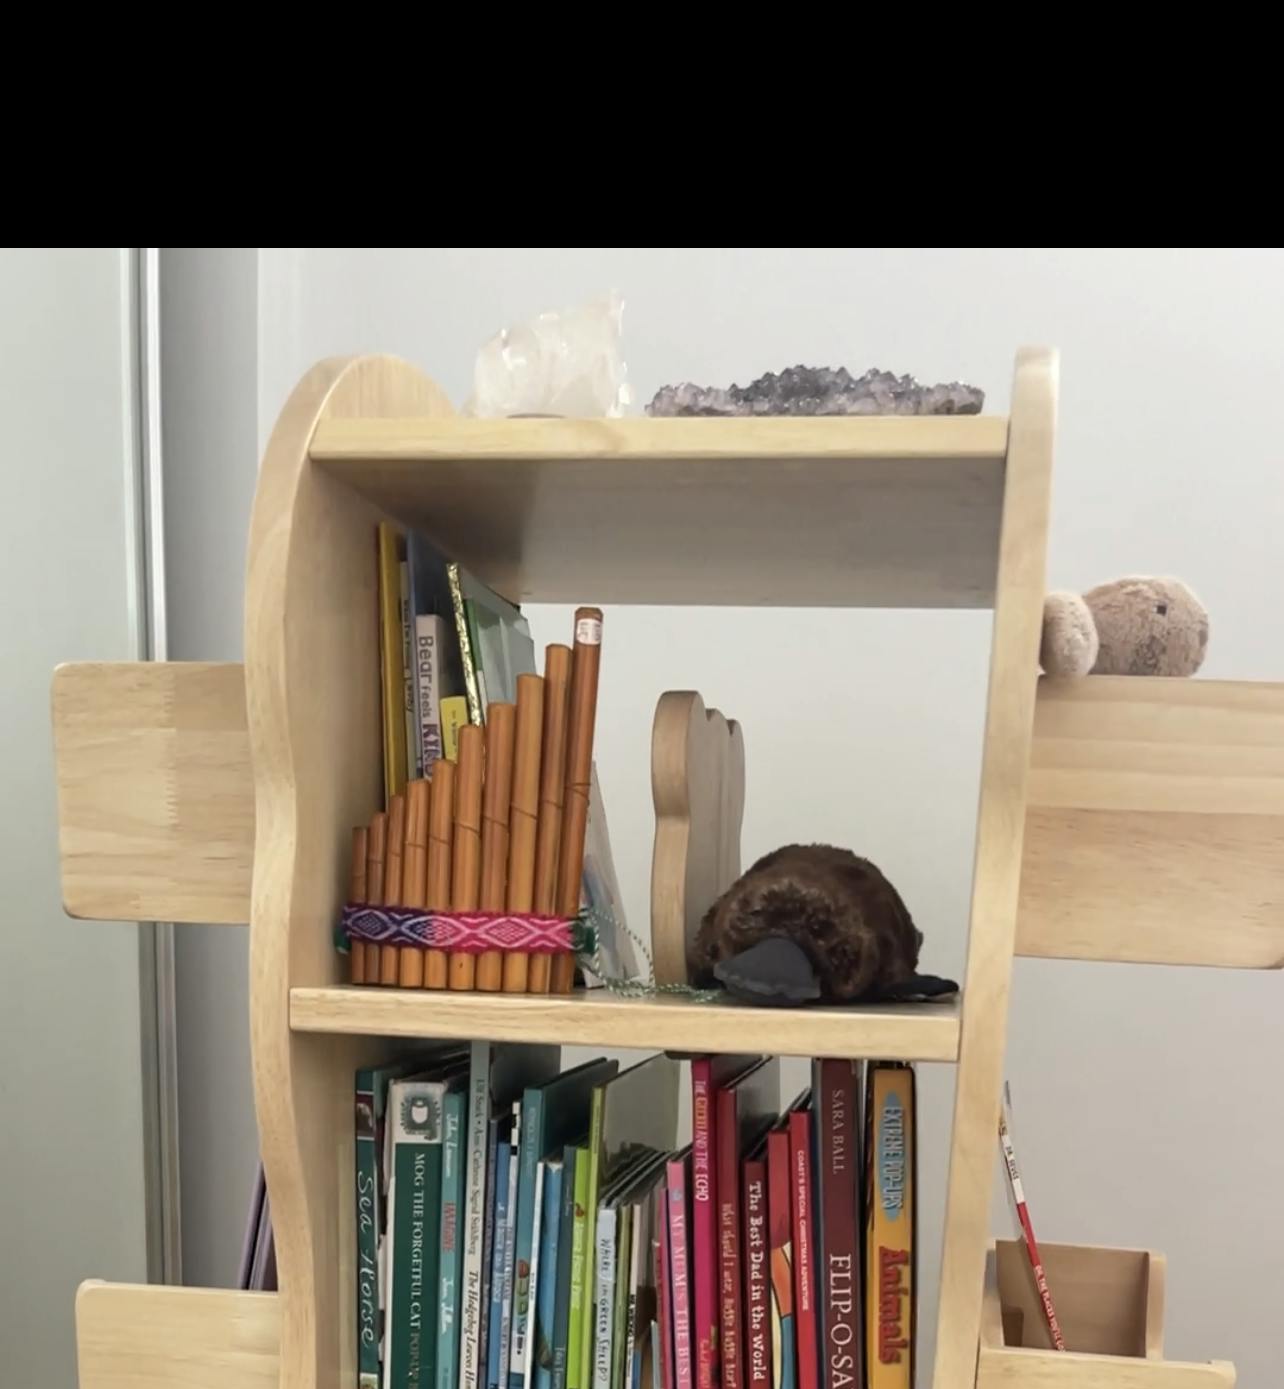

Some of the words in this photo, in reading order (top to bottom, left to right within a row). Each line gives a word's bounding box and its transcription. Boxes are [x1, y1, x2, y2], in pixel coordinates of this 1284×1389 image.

[418, 636, 435, 683] Bear
[421, 685, 432, 717] feels
[694, 1080, 707, 1095] THE
[830, 1088, 846, 1130] SARA
[695, 1130, 708, 1149] AND
[882, 1106, 904, 1158] EXTREME
[413, 1152, 425, 1186] MOG
[695, 1151, 709, 1172] THE
[796, 1150, 806, 1184] COAST'S
[830, 1134, 847, 1175] BALL
[357, 1170, 374, 1232] Sea
[694, 1173, 709, 1202] ECHO
[748, 1180, 762, 1212] The
[797, 1185, 807, 1218] SPECIAL
[879, 1161, 904, 1210] POP-UPS
[413, 1190, 424, 1217] THE
[749, 1214, 764, 1247] Best
[798, 1219, 808, 1264] CHRISTMAS
[410, 1221, 424, 1299] FORGETFUL
[750, 1249, 764, 1281] Dad
[468, 1270, 479, 1287] The
[751, 1283, 765, 1301] in
[800, 1265, 810, 1312] ADVENTURE
[359, 1248, 375, 1347] Horse
[409, 1301, 422, 1328] CAT
[878, 1246, 909, 1365] Animals
[599, 1297, 610, 1334] GREEN
[675, 1307, 690, 1342] THE
[751, 1303, 766, 1330] the
[678, 1345, 692, 1385] BEST
[751, 1332, 767, 1380] World
